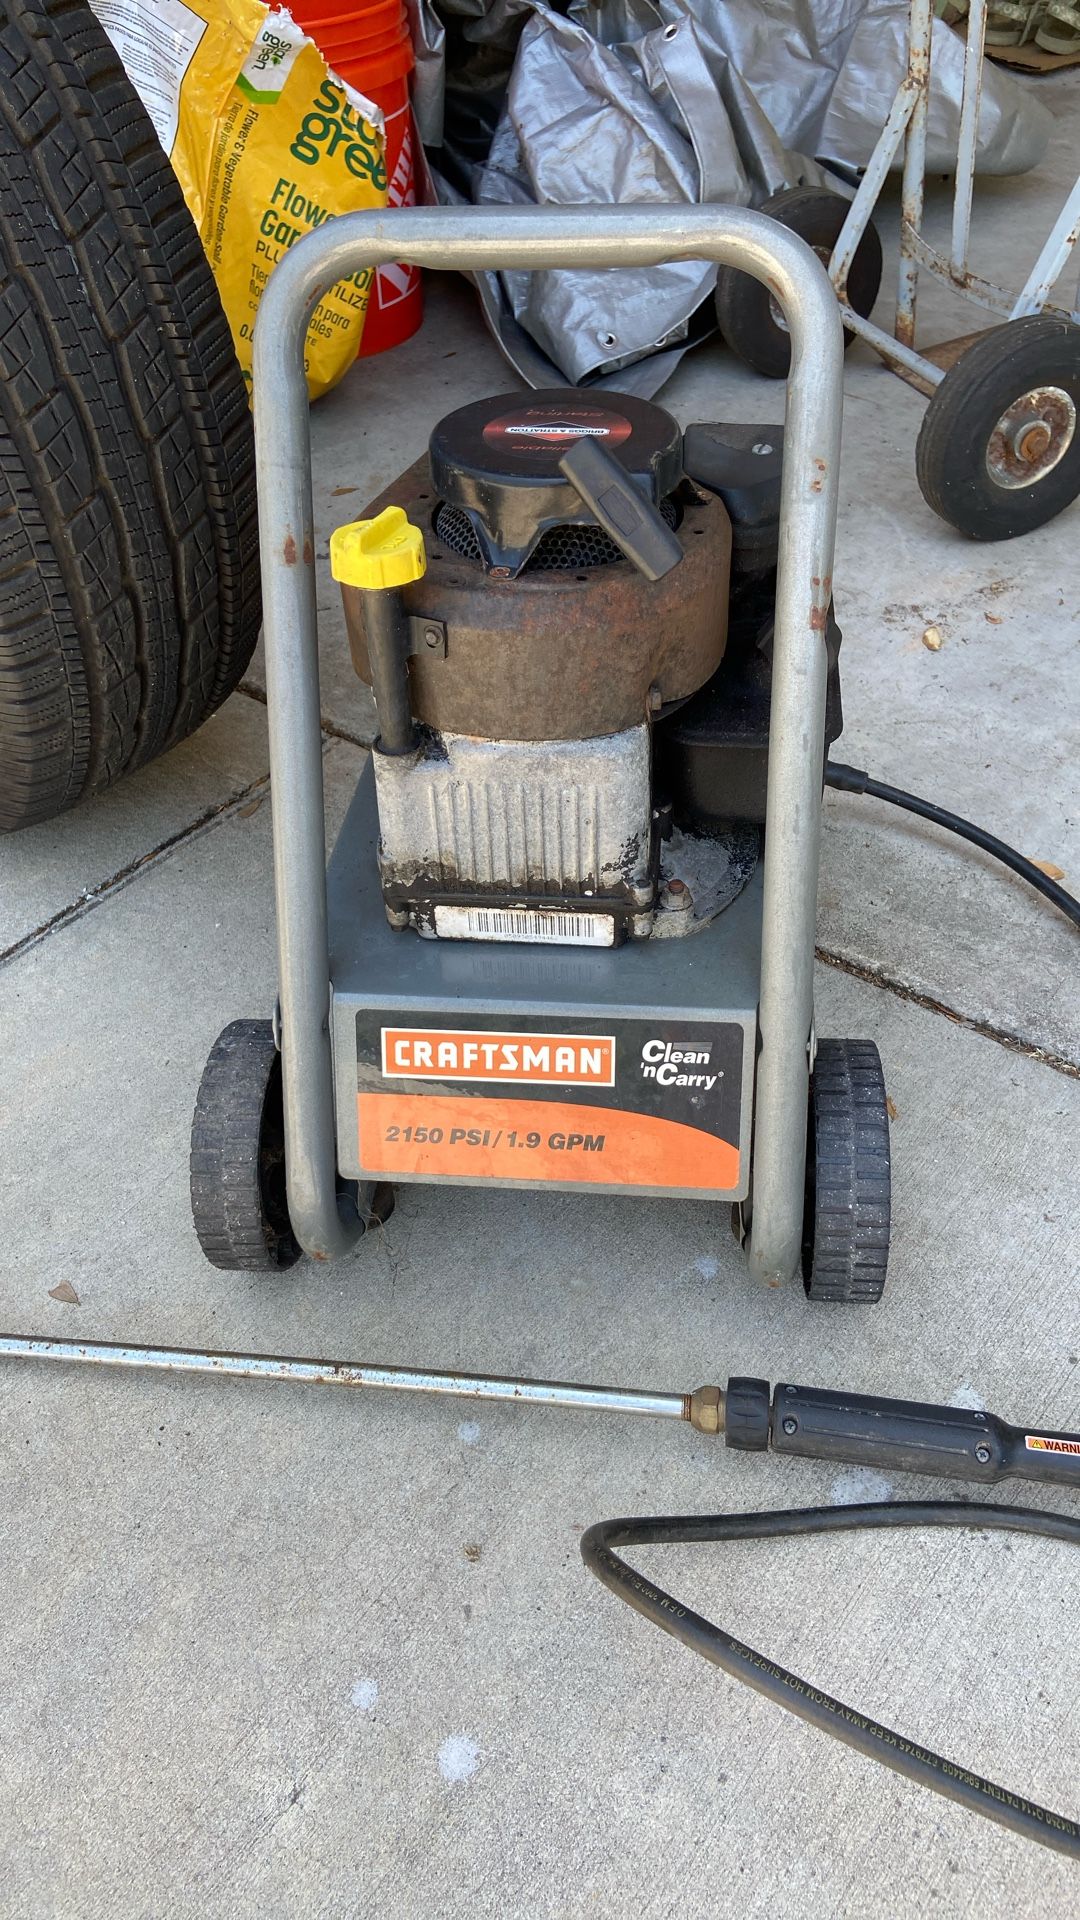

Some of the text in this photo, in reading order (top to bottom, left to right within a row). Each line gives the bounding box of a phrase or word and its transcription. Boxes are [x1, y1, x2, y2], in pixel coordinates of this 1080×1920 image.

[253, 31, 281, 70] green
[239, 108, 259, 142] Flower
[222, 151, 243, 204] Vegetable
[215, 204, 229, 240] Garden
[310, 317, 333, 338] ales
[322, 308, 350, 330] para
[394, 1039, 711, 1075] CRAFTSMAN Clean
[385, 1126, 444, 1144] 2150
[548, 1132, 605, 1152] GPM
[729, 1641, 781, 1679] SURFACES
[783, 1678, 805, 1694] HOT
[806, 1692, 837, 1712] FROM
[838, 1711, 869, 1729] AWAY
[869, 1726, 897, 1746] KEEP
[982, 1785, 1019, 1808] PATENT
